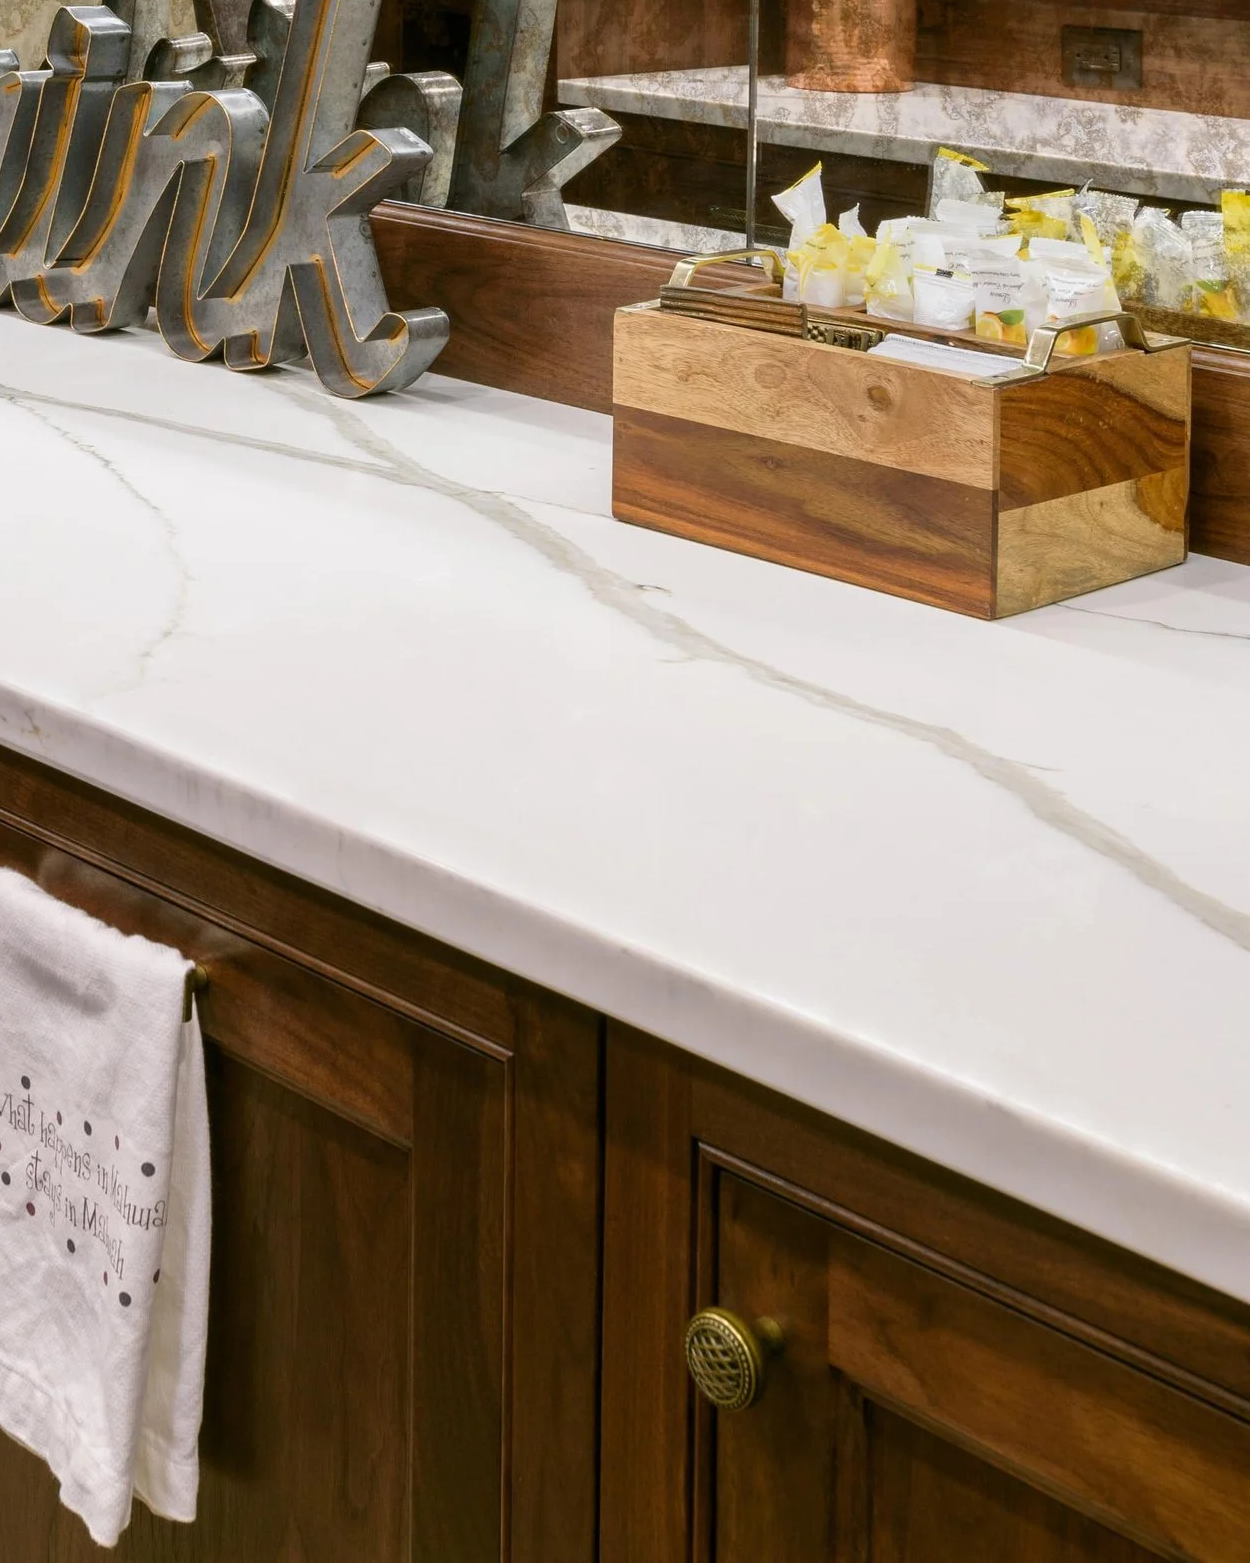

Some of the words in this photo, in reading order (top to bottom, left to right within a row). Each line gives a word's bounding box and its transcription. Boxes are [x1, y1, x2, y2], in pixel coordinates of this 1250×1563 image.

[25, 1150, 63, 1228] stays
[64, 1197, 78, 1227] in
[40, 1110, 92, 1181] happens
[97, 1163, 108, 1195] in
